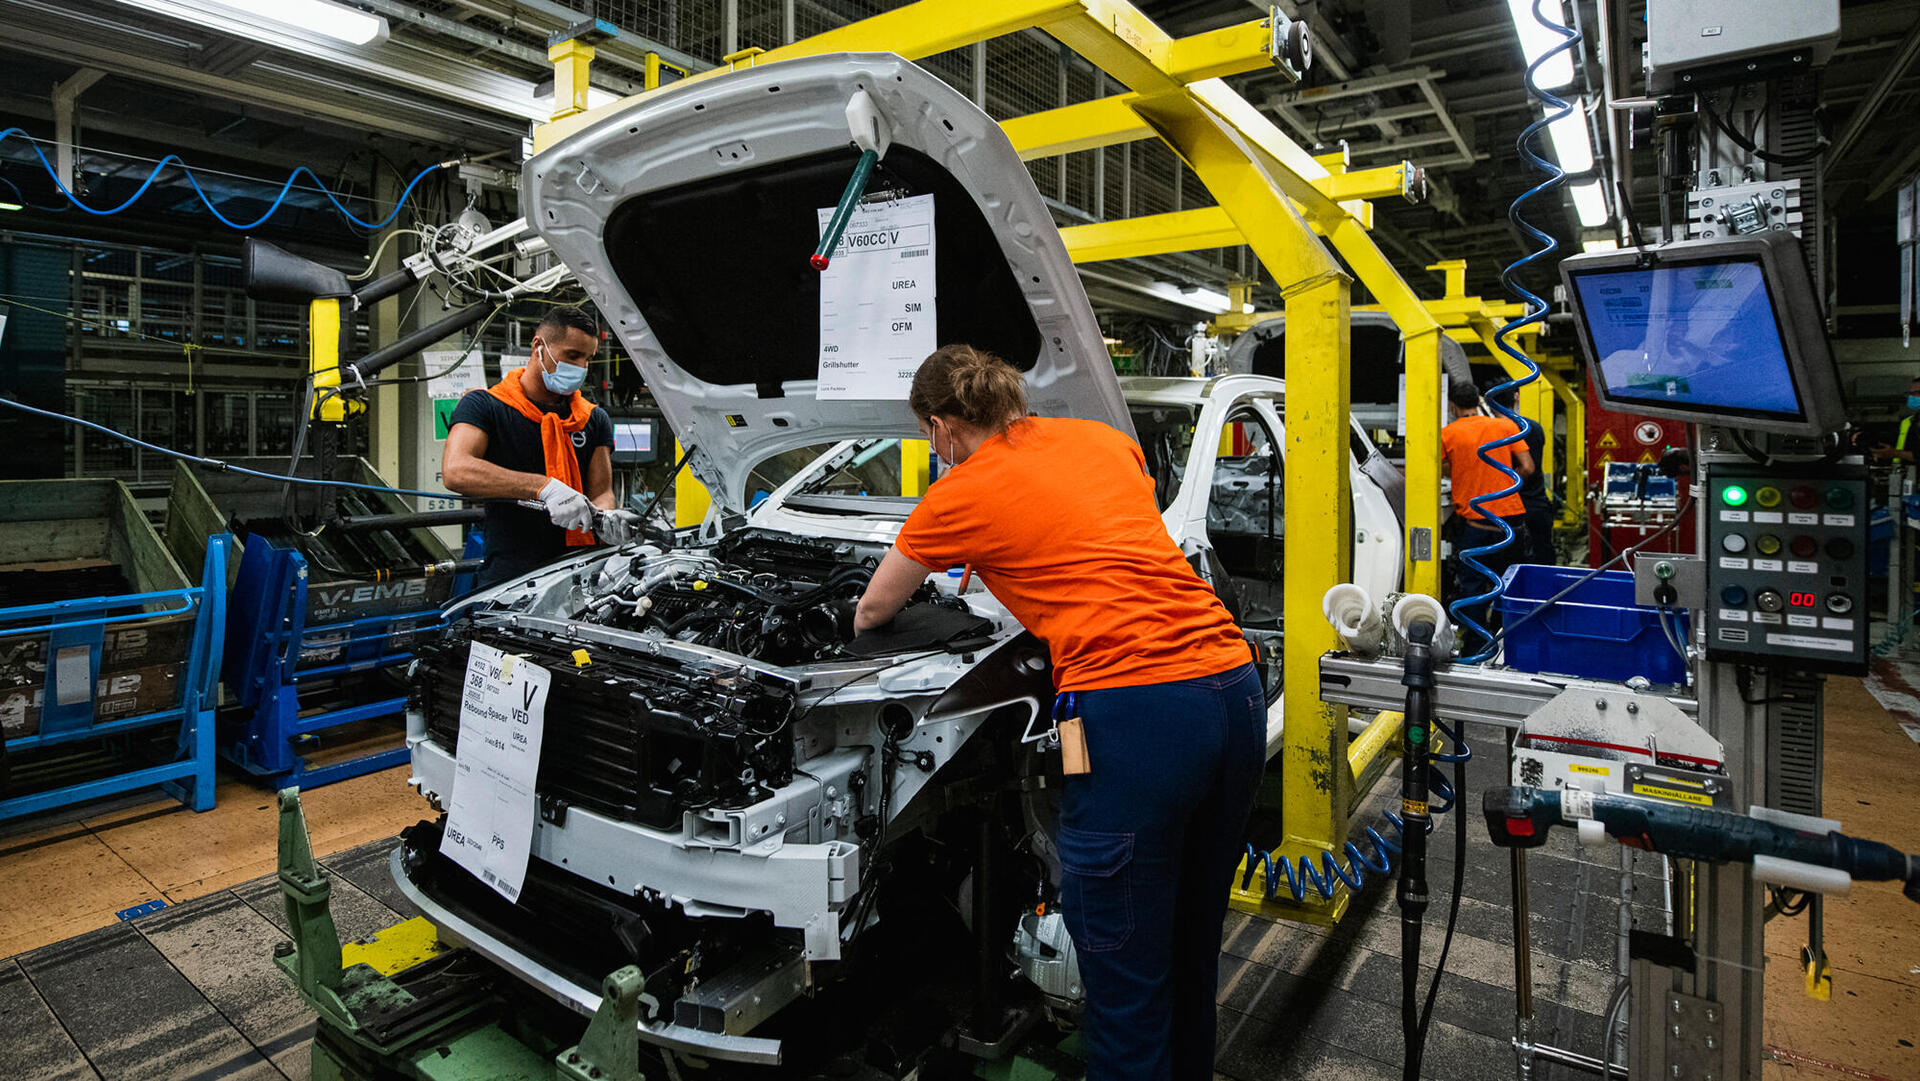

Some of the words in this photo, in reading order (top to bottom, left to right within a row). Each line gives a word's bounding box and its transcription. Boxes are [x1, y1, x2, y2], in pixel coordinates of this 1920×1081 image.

[848, 232, 887, 247] V60CC
[890, 231, 899, 244] V
[892, 280, 916, 290] UREA
[905, 303, 922, 313] SIM
[891, 321, 913, 332] OFM
[823, 345, 839, 353] 4WD
[822, 361, 860, 369] Grillshutter
[1790, 592, 1816, 607] 00
[470, 673, 484, 688] 368
[523, 680, 539, 712] V
[464, 700, 488, 719] Rebound
[487, 706, 508, 723] Spacer
[511, 707, 529, 725] VED
[512, 731, 528, 745] UREA
[447, 826, 465, 847] UREA
[491, 834, 505, 850] PPS
